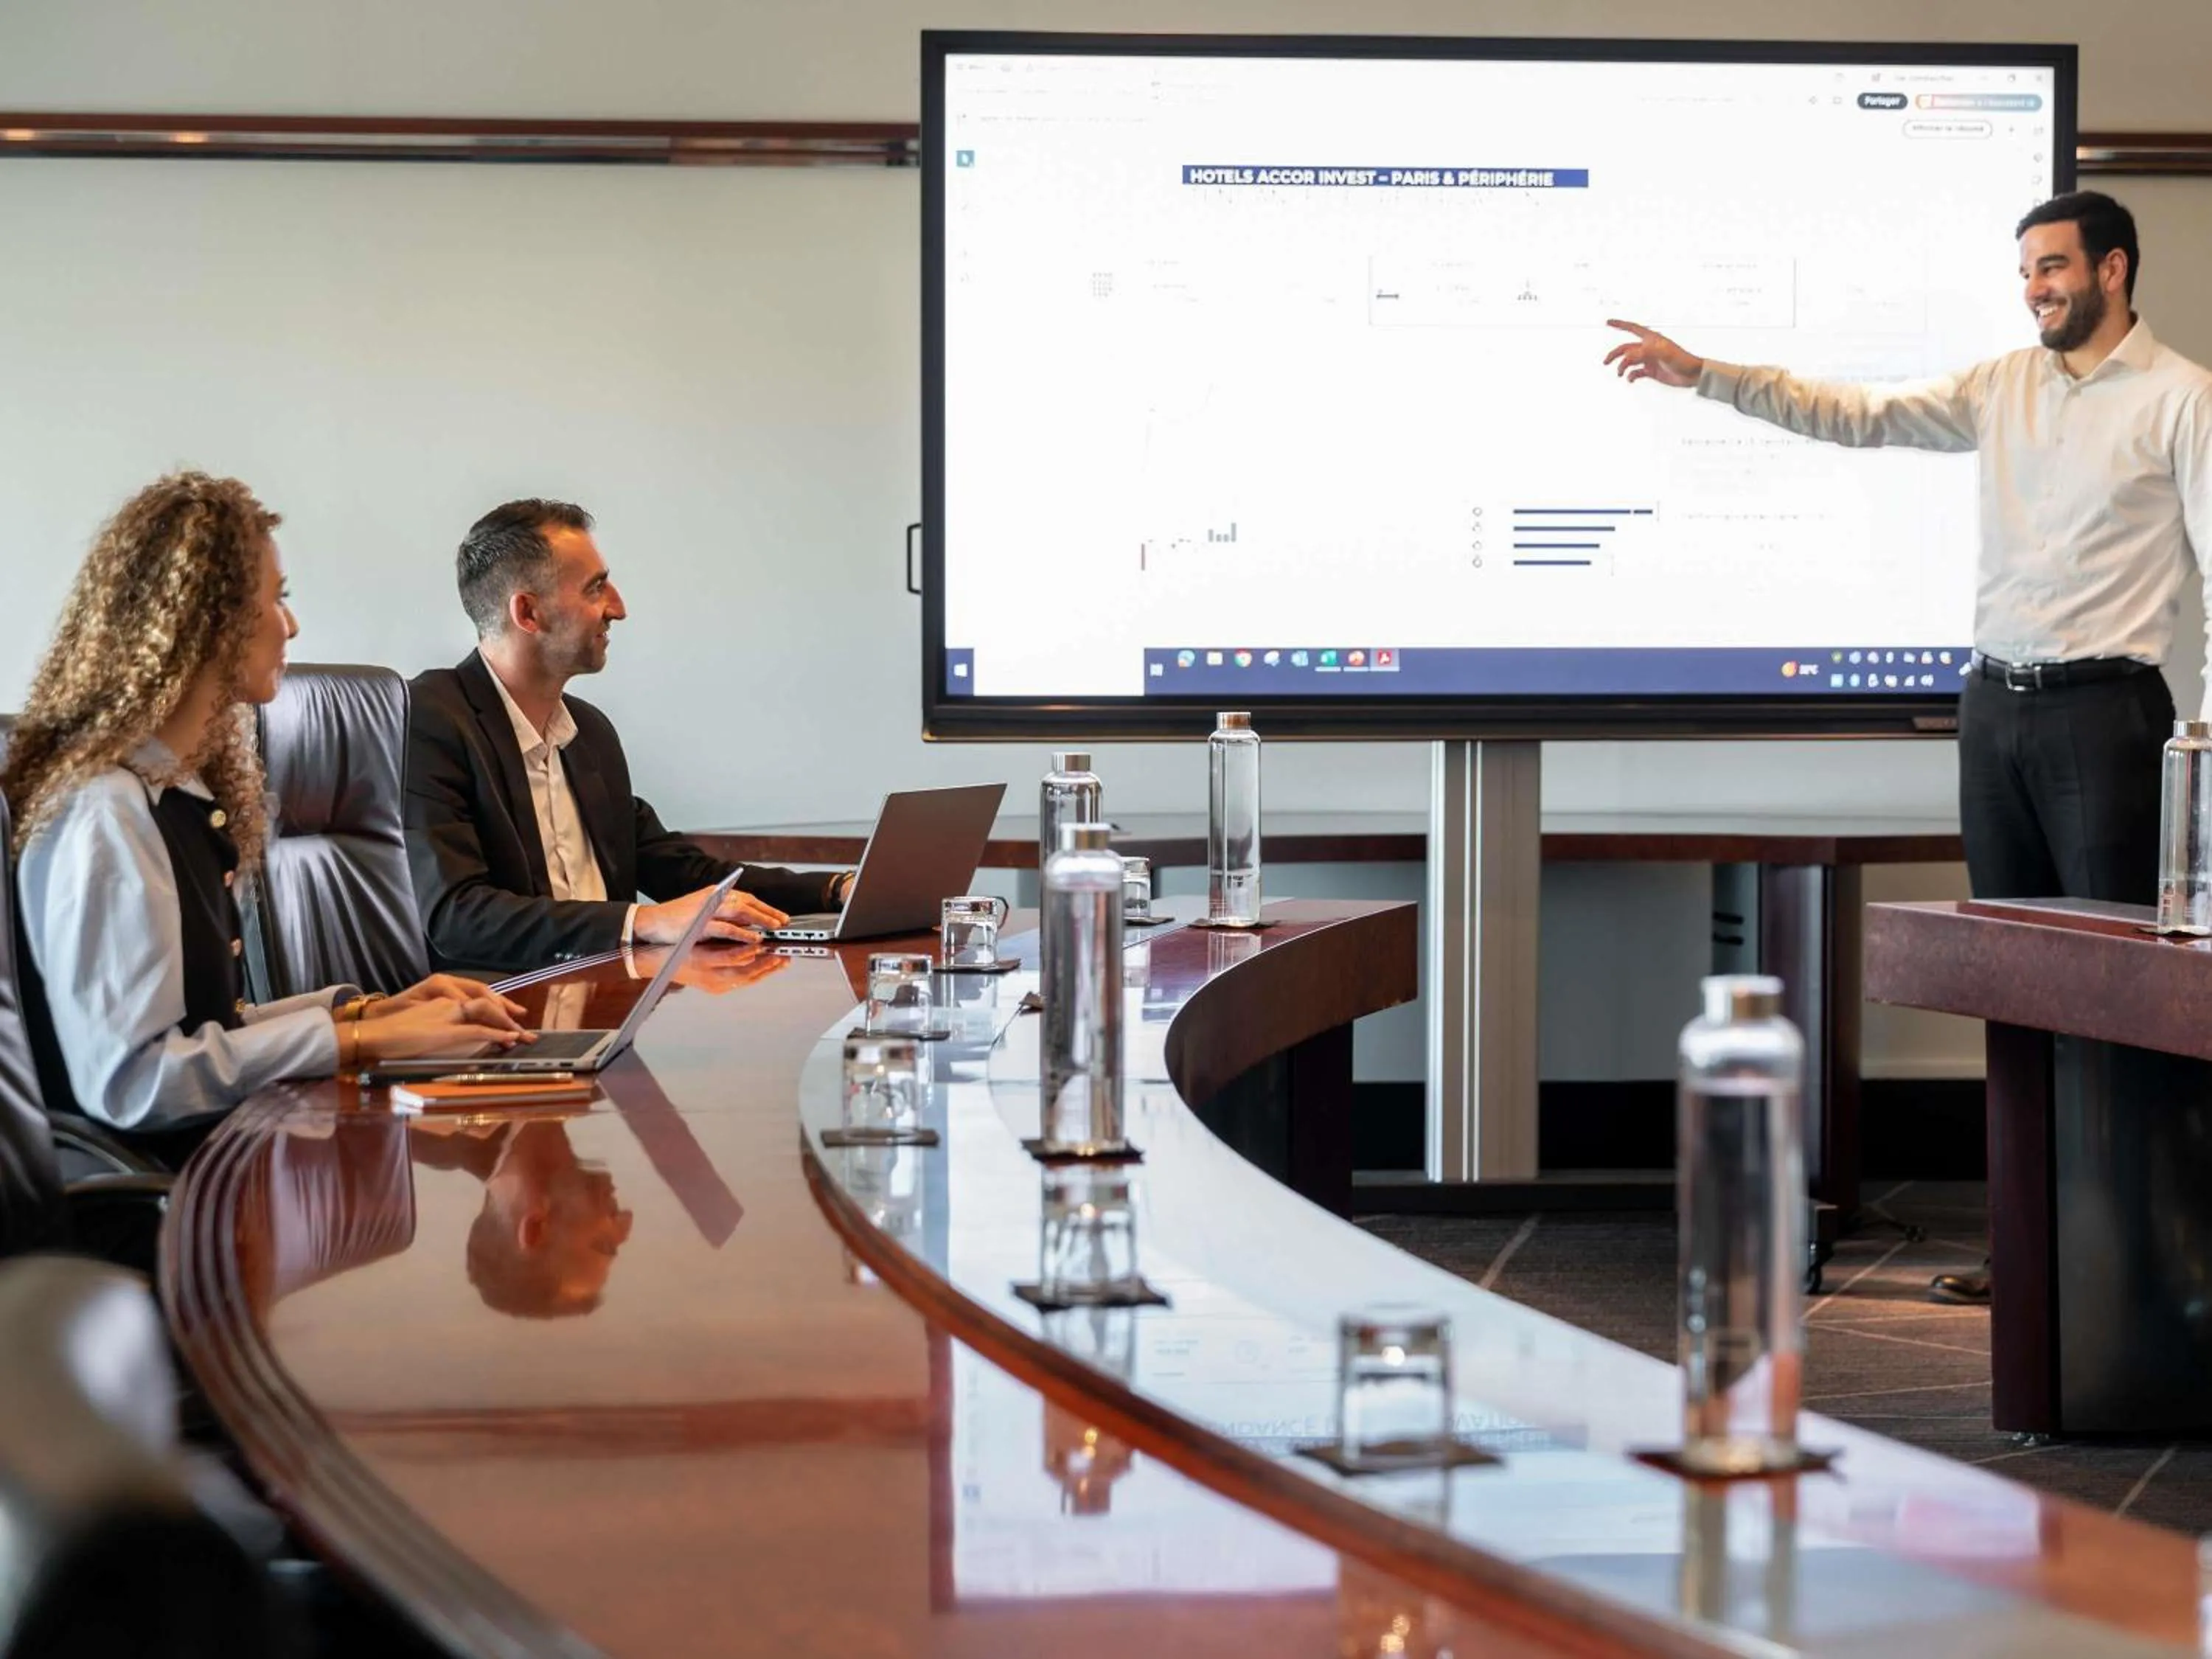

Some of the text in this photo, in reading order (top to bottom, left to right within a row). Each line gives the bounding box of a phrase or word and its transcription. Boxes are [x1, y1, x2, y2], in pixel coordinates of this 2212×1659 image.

[1190, 168, 1253, 184] HOTELS
[1256, 169, 1315, 184] ACCOR
[1318, 170, 1377, 184] INVEST
[1392, 170, 1439, 185] PARIS
[1442, 171, 1455, 185] &
[1458, 170, 1554, 187] PÉRIPHÉRIE
